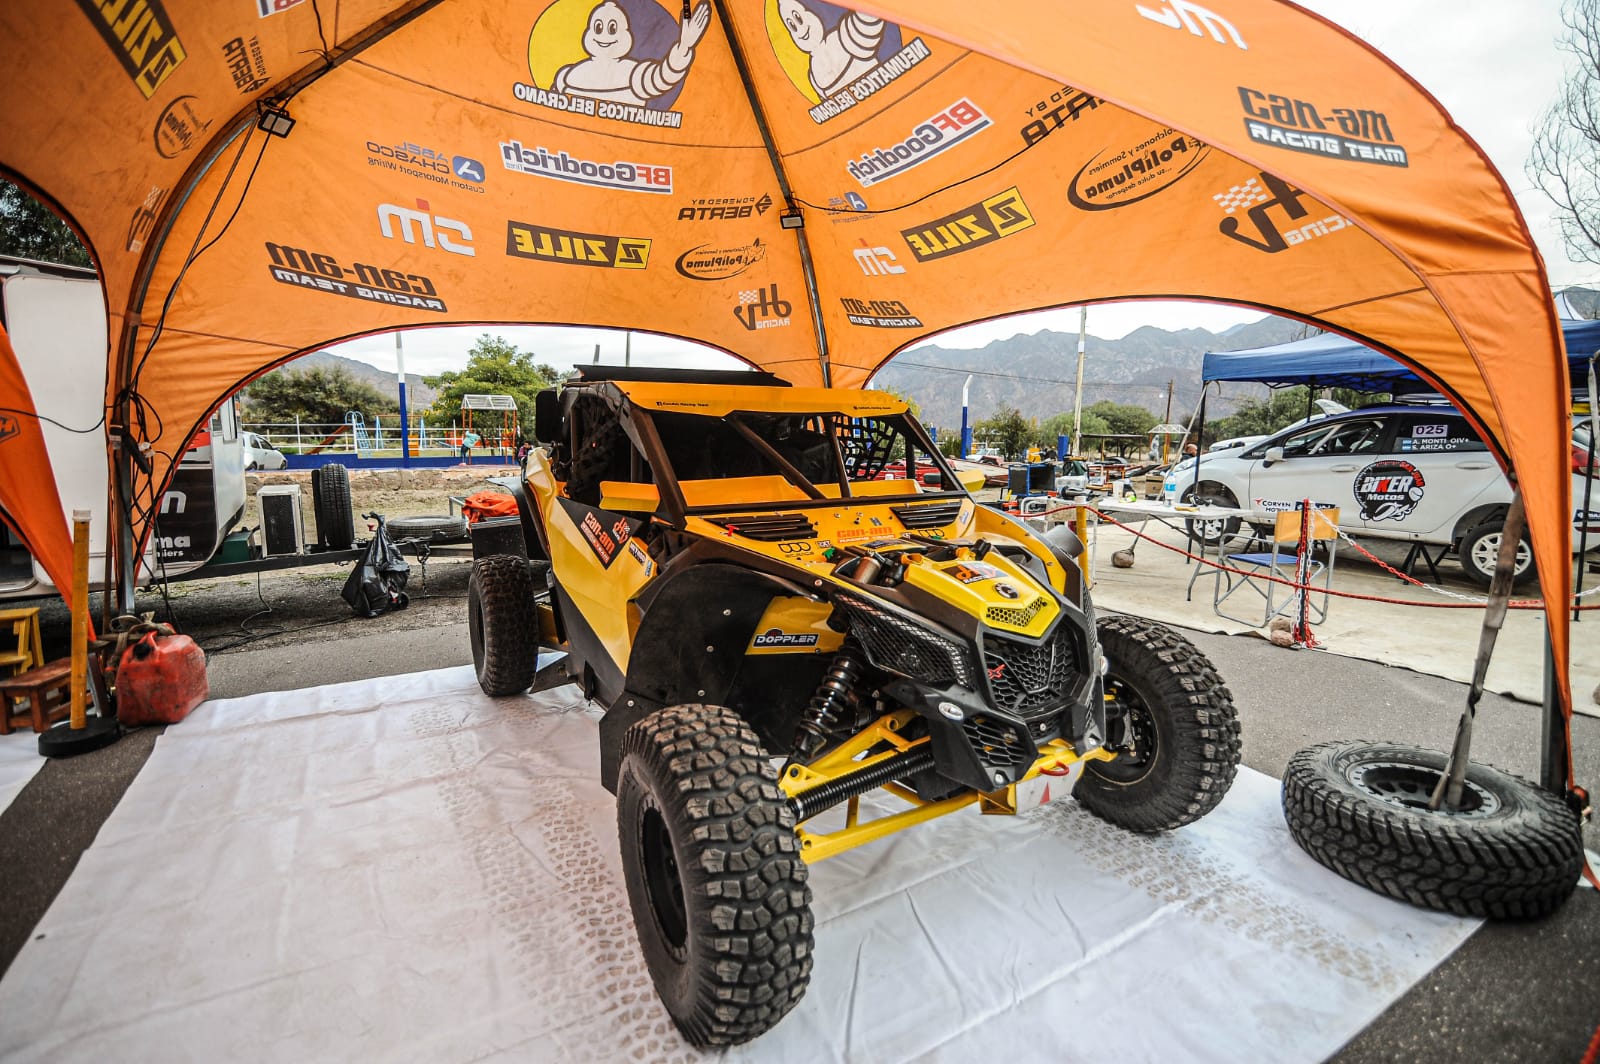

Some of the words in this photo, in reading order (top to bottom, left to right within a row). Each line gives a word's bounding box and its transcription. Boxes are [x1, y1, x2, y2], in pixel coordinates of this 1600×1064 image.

[1249, 123, 1341, 154] RACING
[1344, 141, 1406, 164] TEAM
[1416, 425, 1444, 435] 025
[1360, 475, 1414, 493] BIKER
[1262, 500, 1291, 508] CORVEN
[756, 635, 817, 644] DOPPLER
